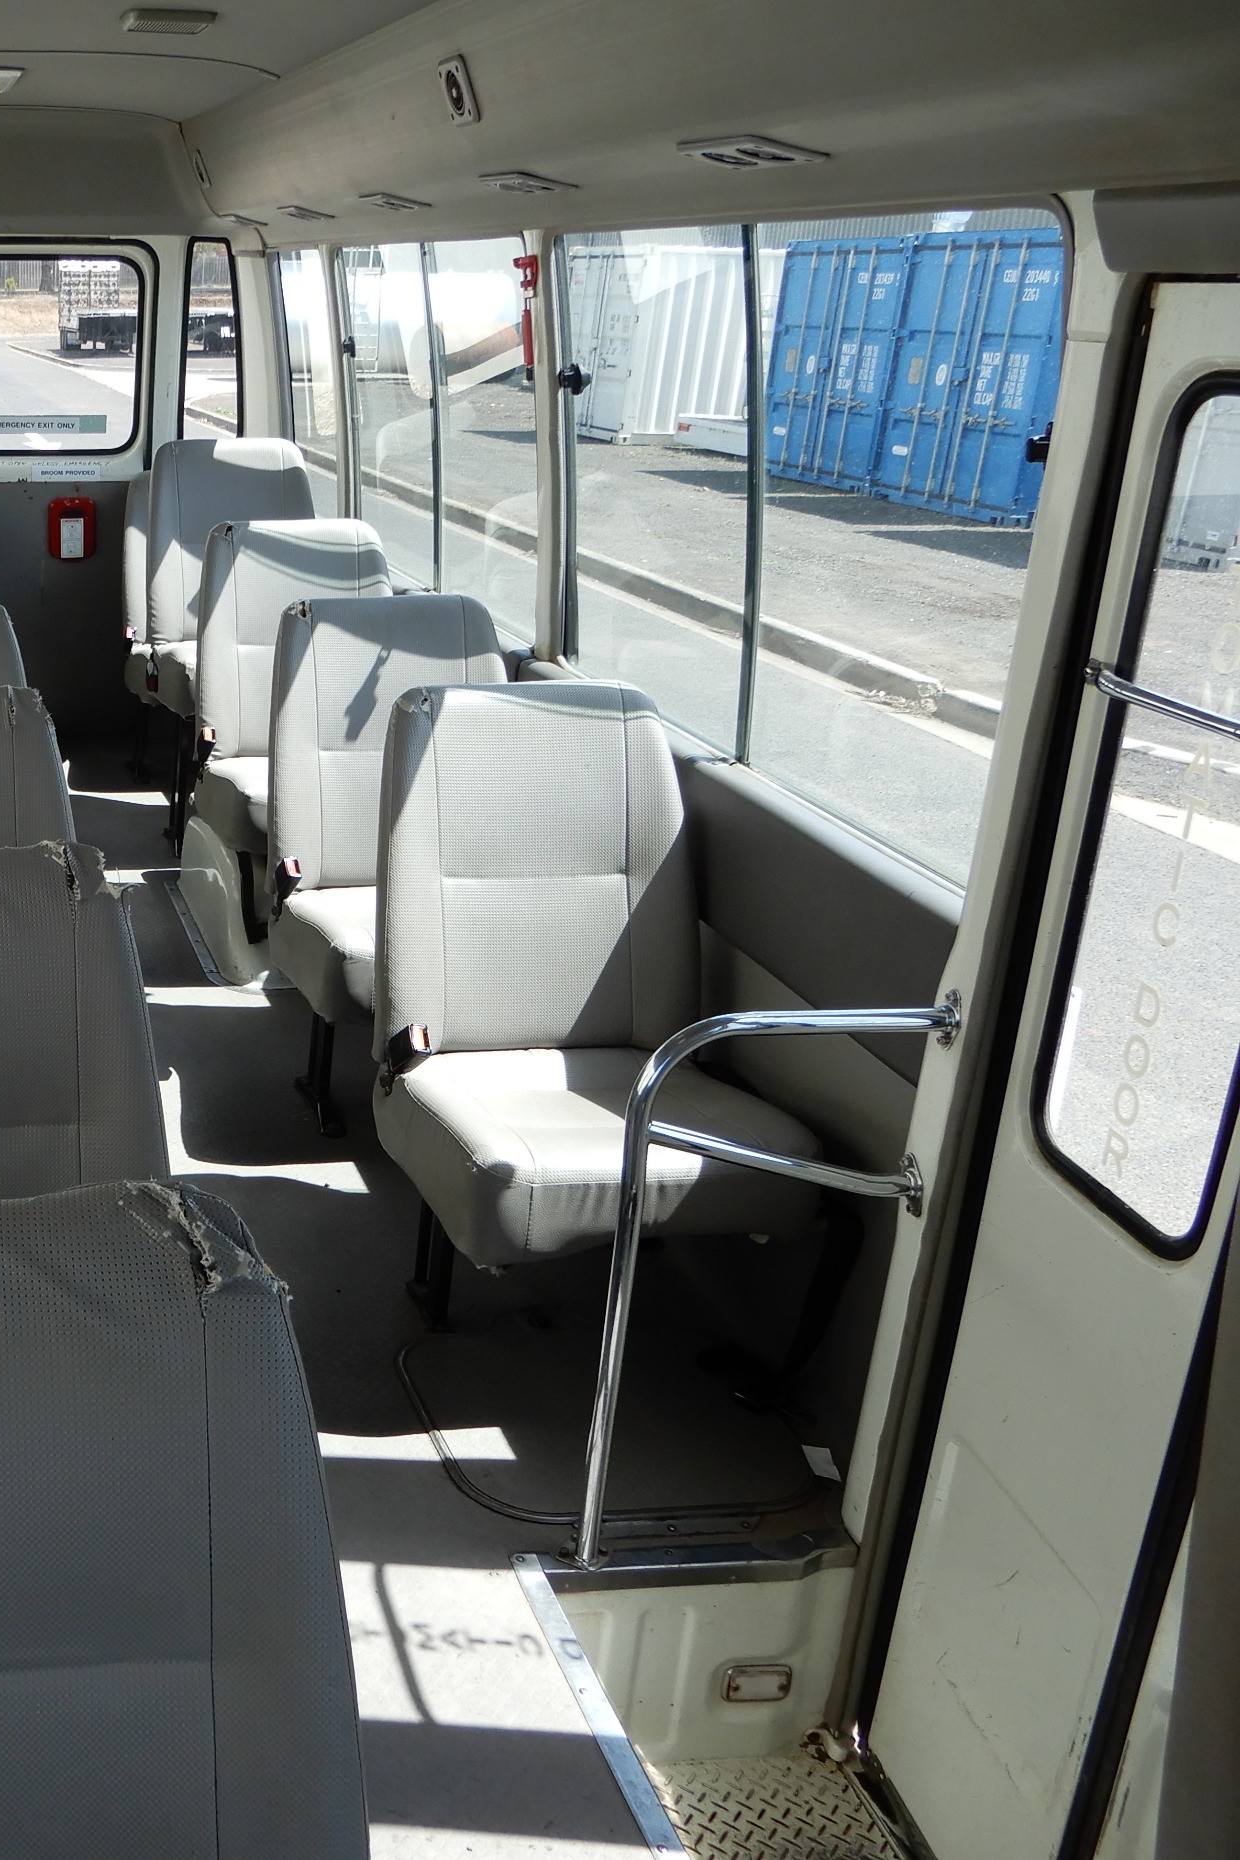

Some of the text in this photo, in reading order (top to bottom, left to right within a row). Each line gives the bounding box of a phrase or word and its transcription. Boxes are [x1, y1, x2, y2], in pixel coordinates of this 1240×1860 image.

[1022, 288, 1040, 301] 22G1
[37, 421, 54, 429] EXIT
[1101, 981, 1160, 1178] DOOR
